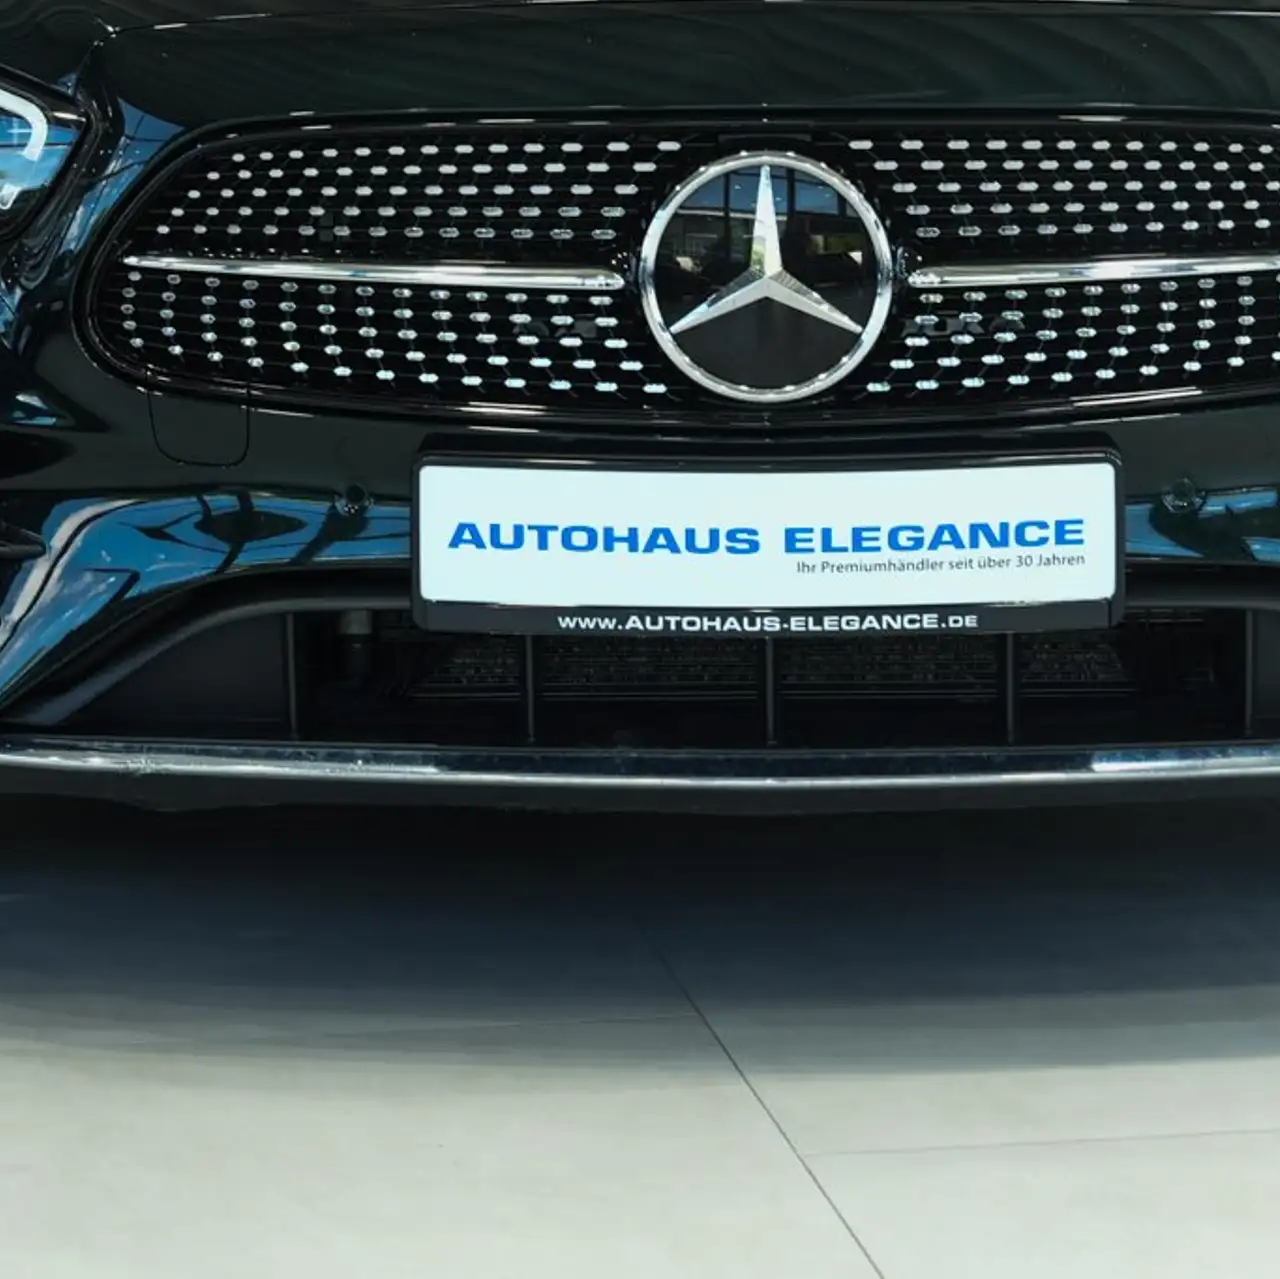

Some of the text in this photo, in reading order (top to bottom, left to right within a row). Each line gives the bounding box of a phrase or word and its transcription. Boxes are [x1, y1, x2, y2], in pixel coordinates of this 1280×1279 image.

[448, 517, 1085, 556] AUTOHAUS ELEGANCE
[796, 552, 1086, 574] Ihr Premiumhändler seit über 30 Jahren
